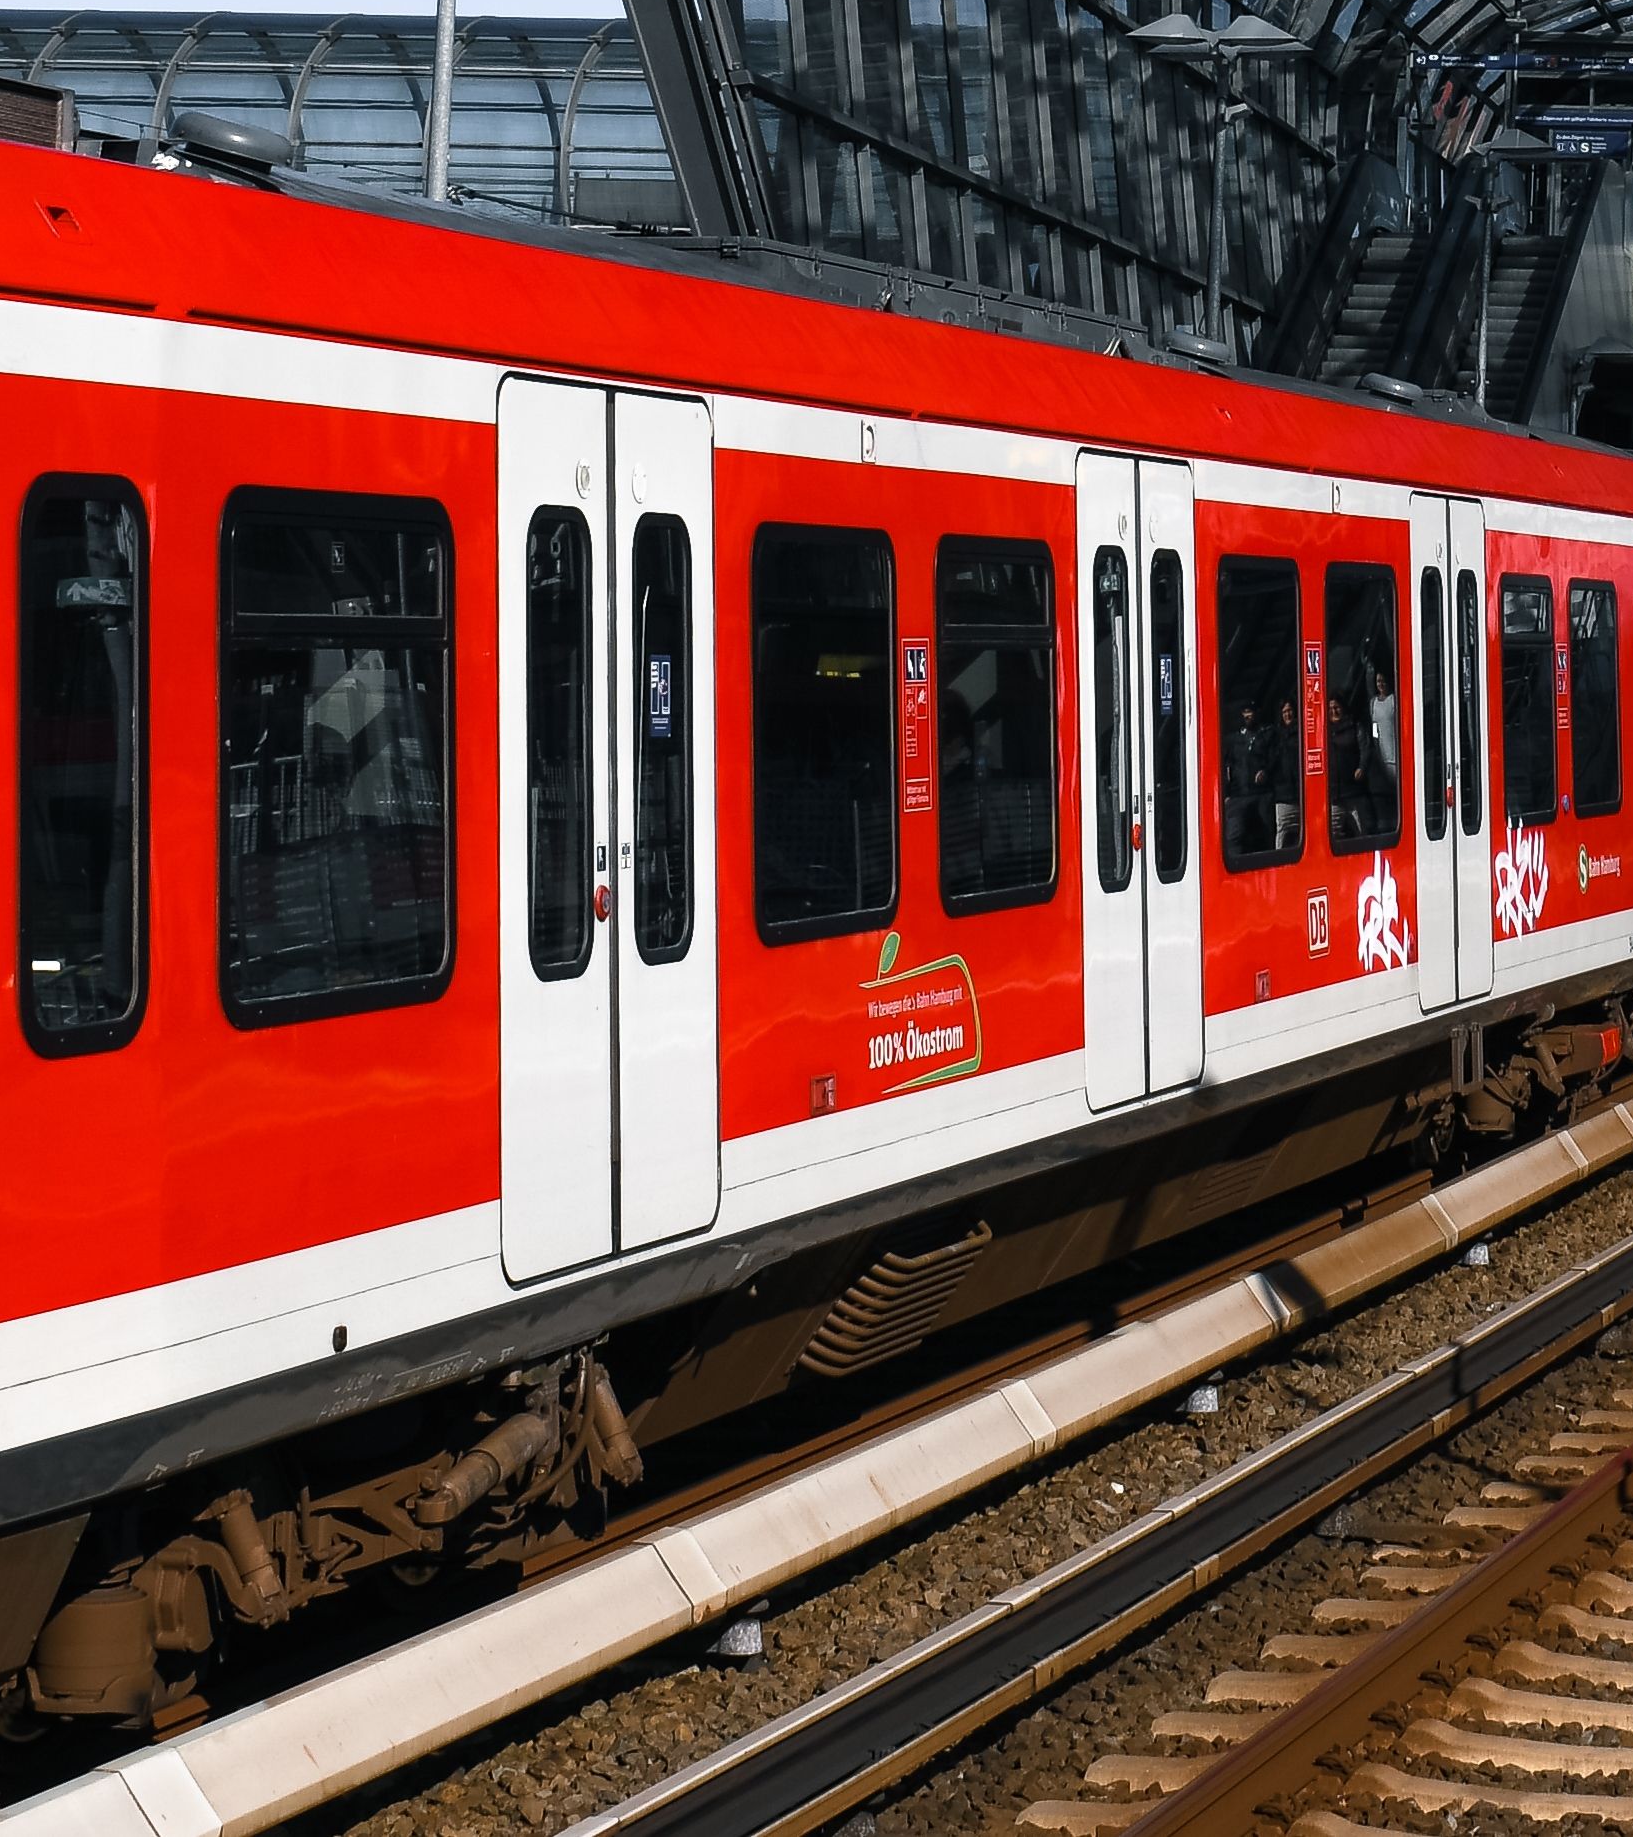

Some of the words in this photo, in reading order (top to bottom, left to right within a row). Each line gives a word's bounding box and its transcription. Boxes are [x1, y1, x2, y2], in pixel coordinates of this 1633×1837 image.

[1580, 142, 1590, 153] S
[1578, 846, 1588, 891] S
[1309, 898, 1327, 947] DB
[868, 1030, 905, 1069] 100%
[906, 1020, 964, 1060] Ökostrom
